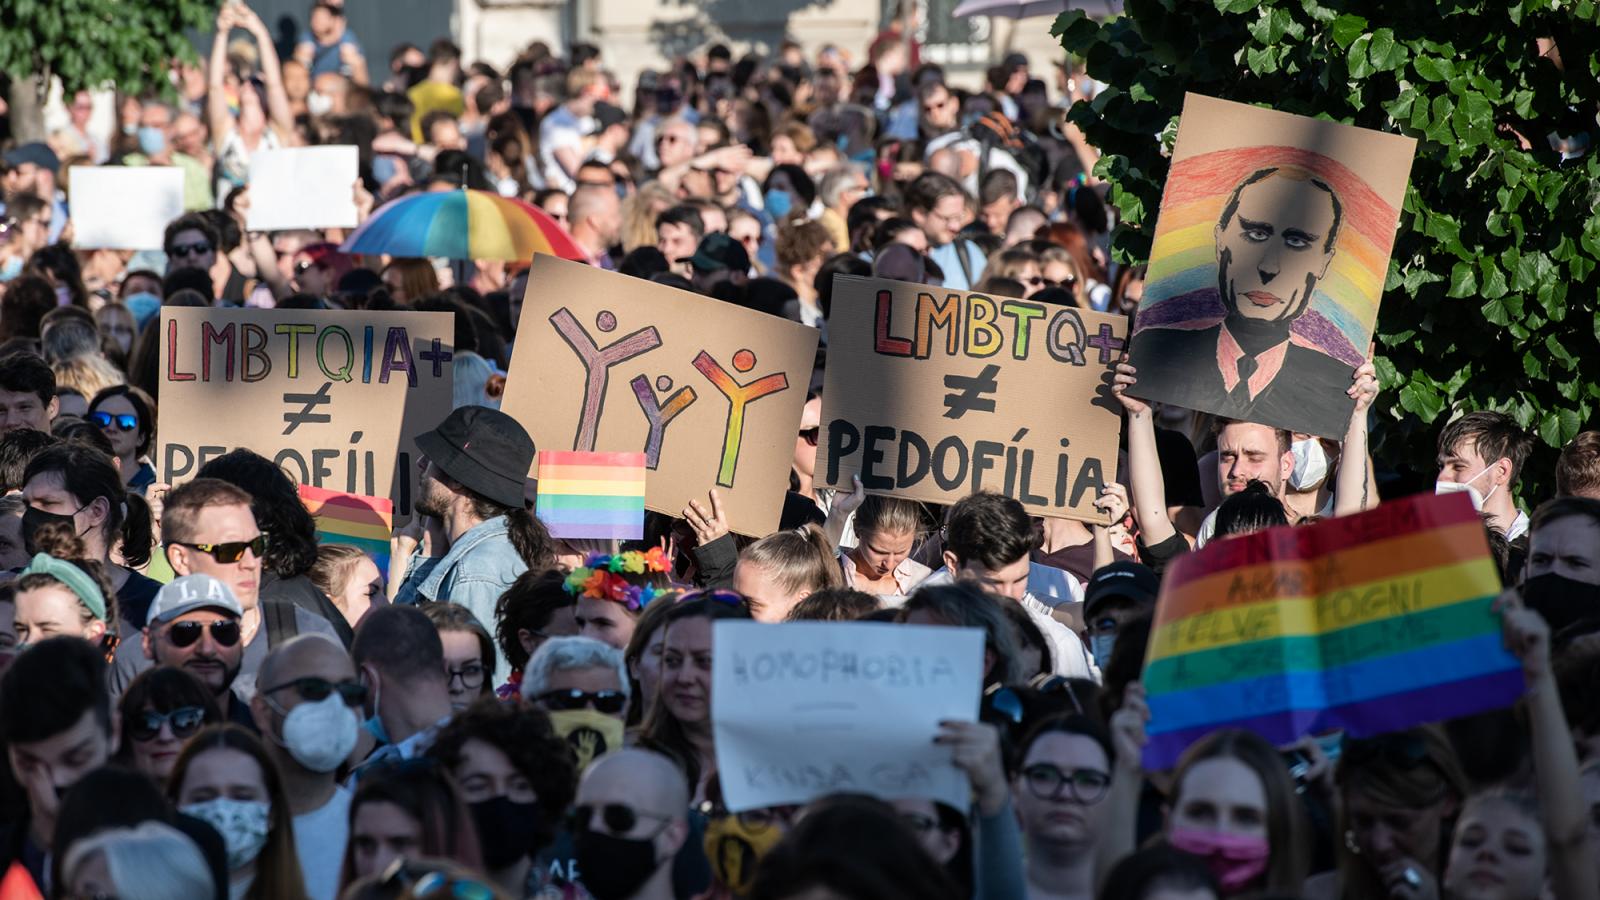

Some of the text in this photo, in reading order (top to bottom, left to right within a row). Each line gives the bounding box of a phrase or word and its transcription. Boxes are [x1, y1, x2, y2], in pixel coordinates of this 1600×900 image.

[167, 318, 453, 388] LMBTQIA+
[874, 289, 1126, 366] LMBTQ+
[732, 648, 958, 688] HOMOPHOBIA
